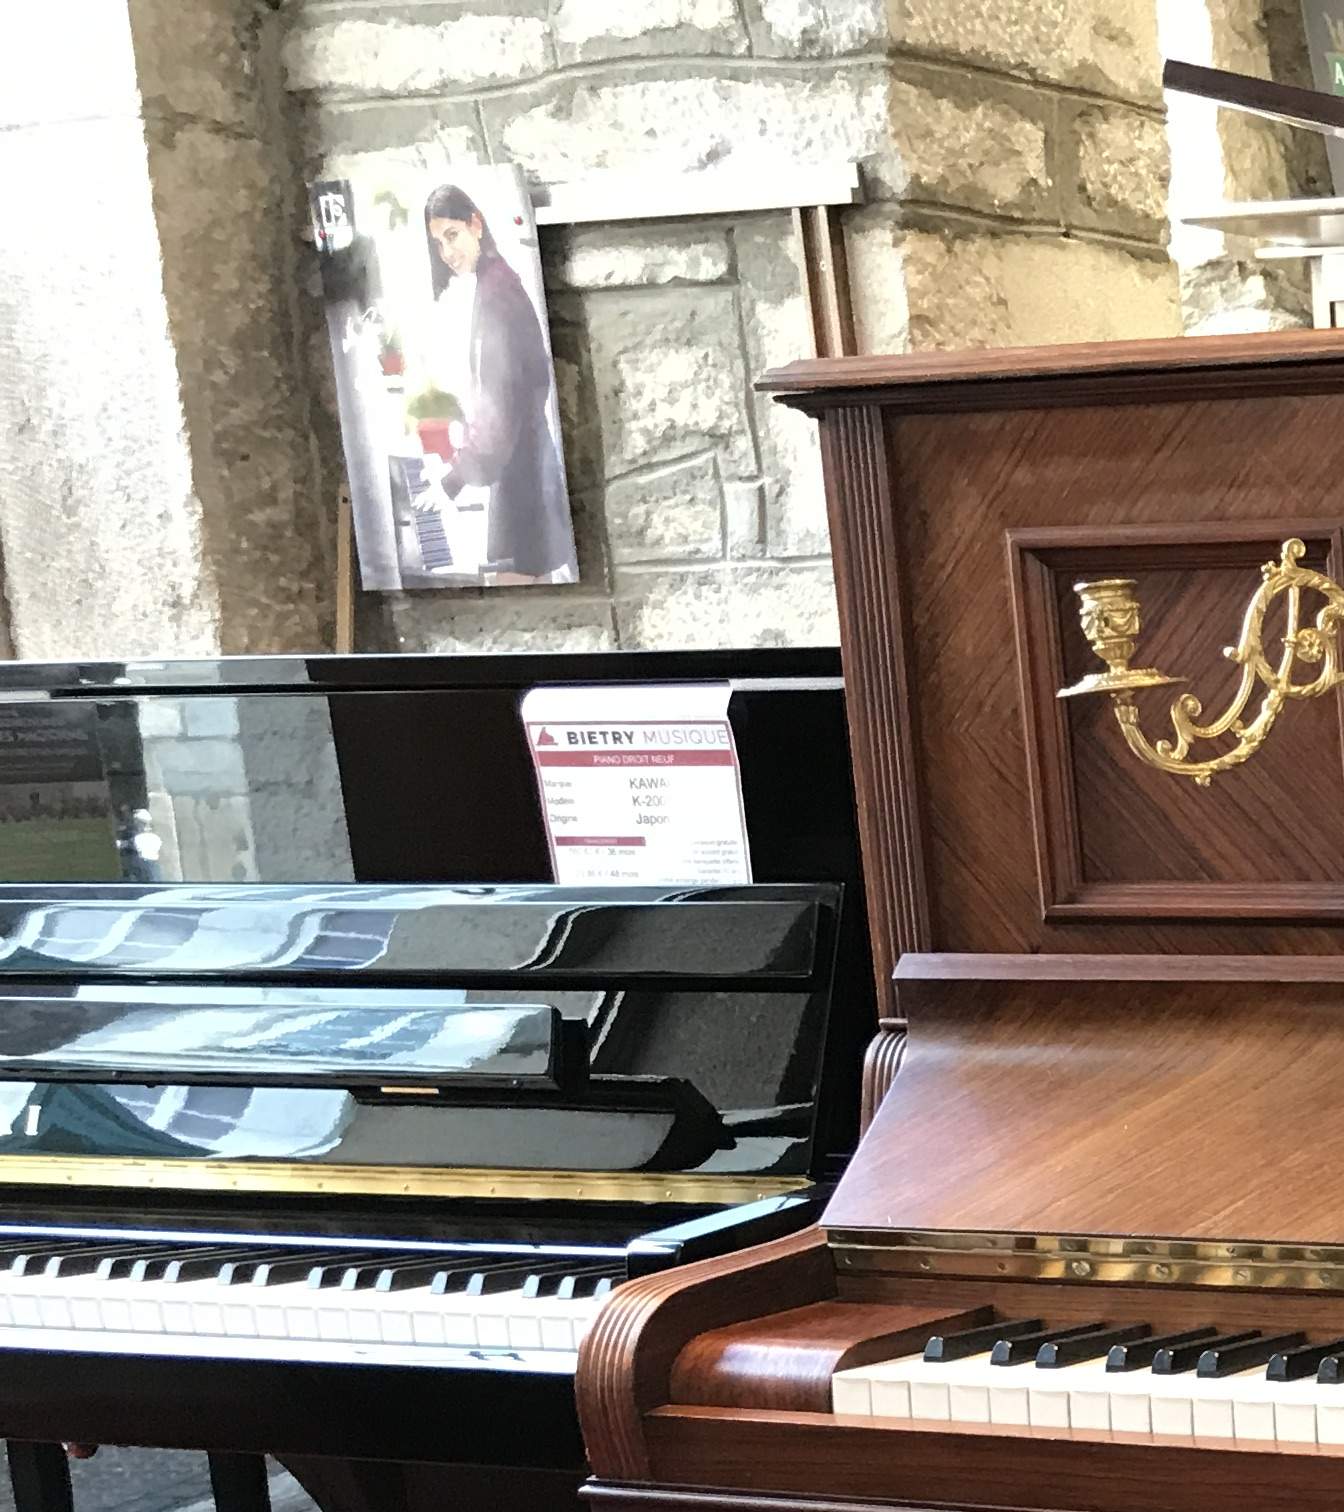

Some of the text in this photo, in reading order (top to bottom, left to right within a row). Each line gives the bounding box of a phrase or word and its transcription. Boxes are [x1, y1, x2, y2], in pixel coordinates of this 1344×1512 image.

[567, 728, 729, 745] BIETRY MUSIQUE
[593, 754, 675, 764] PIANO DROIT NEUF
